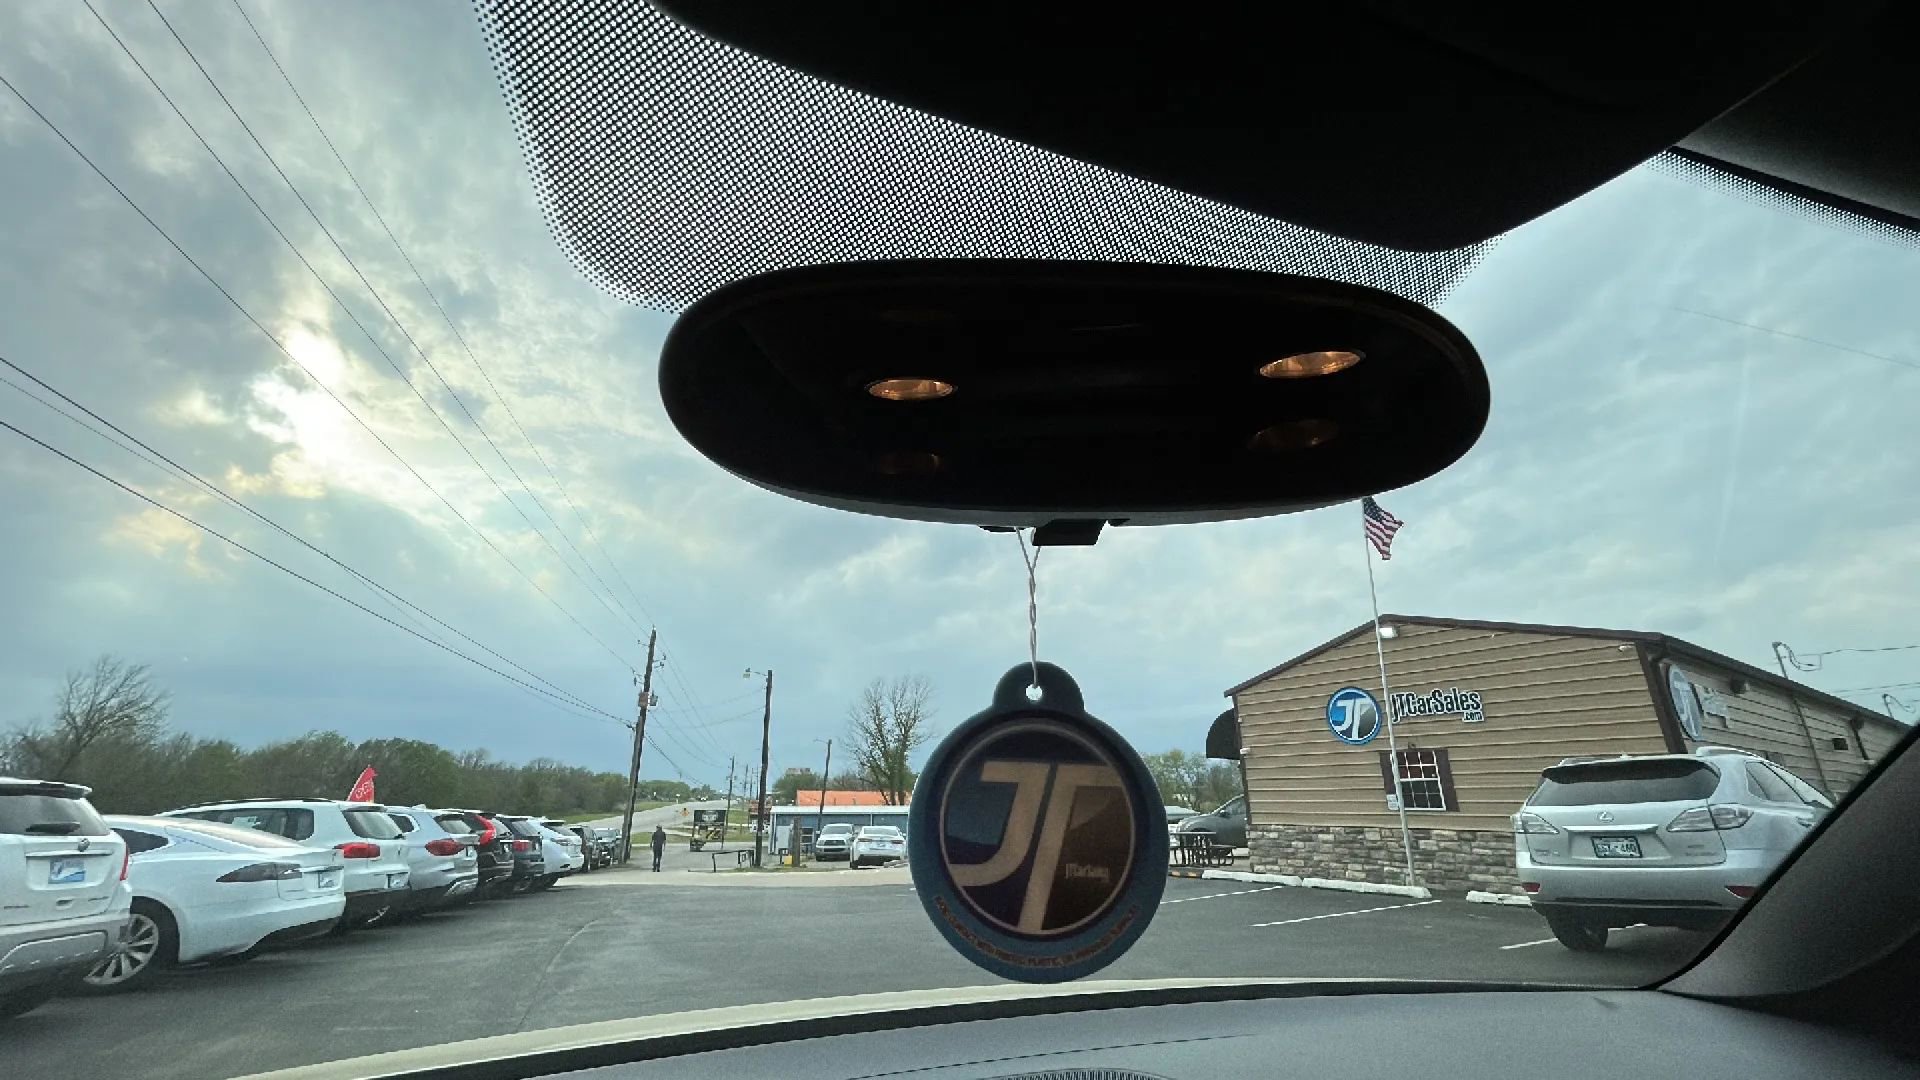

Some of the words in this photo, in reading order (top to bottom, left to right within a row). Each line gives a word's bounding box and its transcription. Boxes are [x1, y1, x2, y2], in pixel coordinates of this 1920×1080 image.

[1334, 697, 1371, 740] JT
[1391, 688, 1482, 723] JTCarSales
[949, 761, 1126, 931] JT
